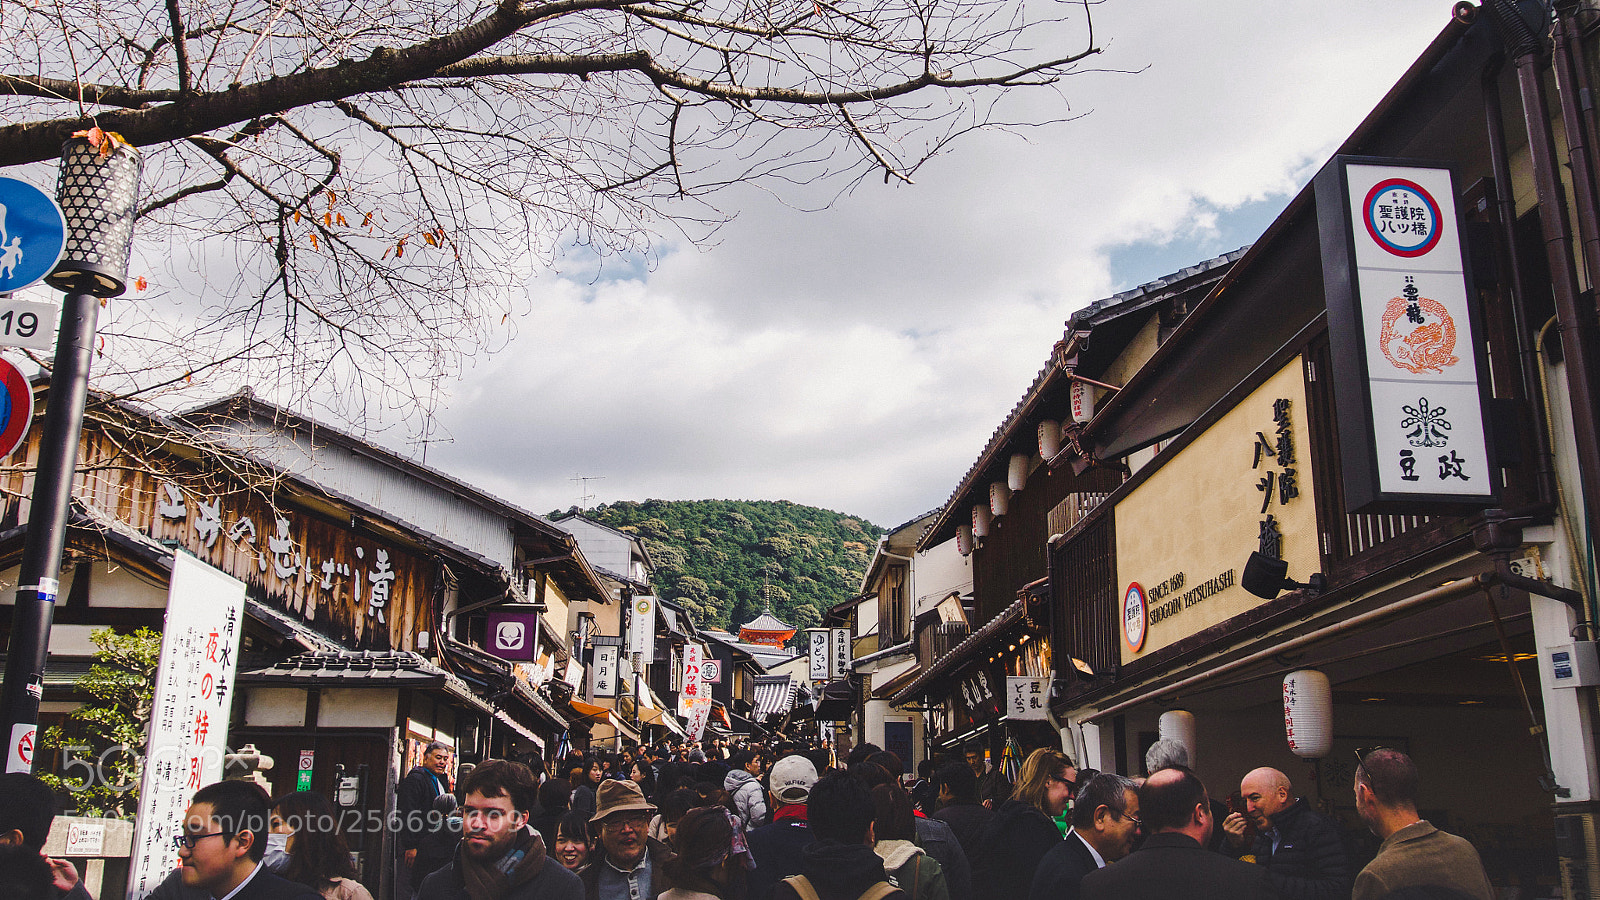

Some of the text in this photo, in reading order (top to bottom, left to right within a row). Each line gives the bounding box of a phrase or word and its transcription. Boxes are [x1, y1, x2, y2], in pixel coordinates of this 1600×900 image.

[1378, 205, 1426, 221] 聖護院
[0, 310, 39, 338] 19
[1272, 398, 1299, 505] 聖護院
[1399, 449, 1471, 481] 豆政
[1148, 580, 1169, 604] SINCE
[1170, 571, 1185, 593] 1689
[1149, 569, 1236, 626] SHOGOIN YATSUHASHI
[215, 605, 238, 708] 清水寺
[813, 634, 826, 671] ゆどうふ
[596, 653, 609, 690] 日月庵
[1029, 681, 1043, 709] 豆乳
